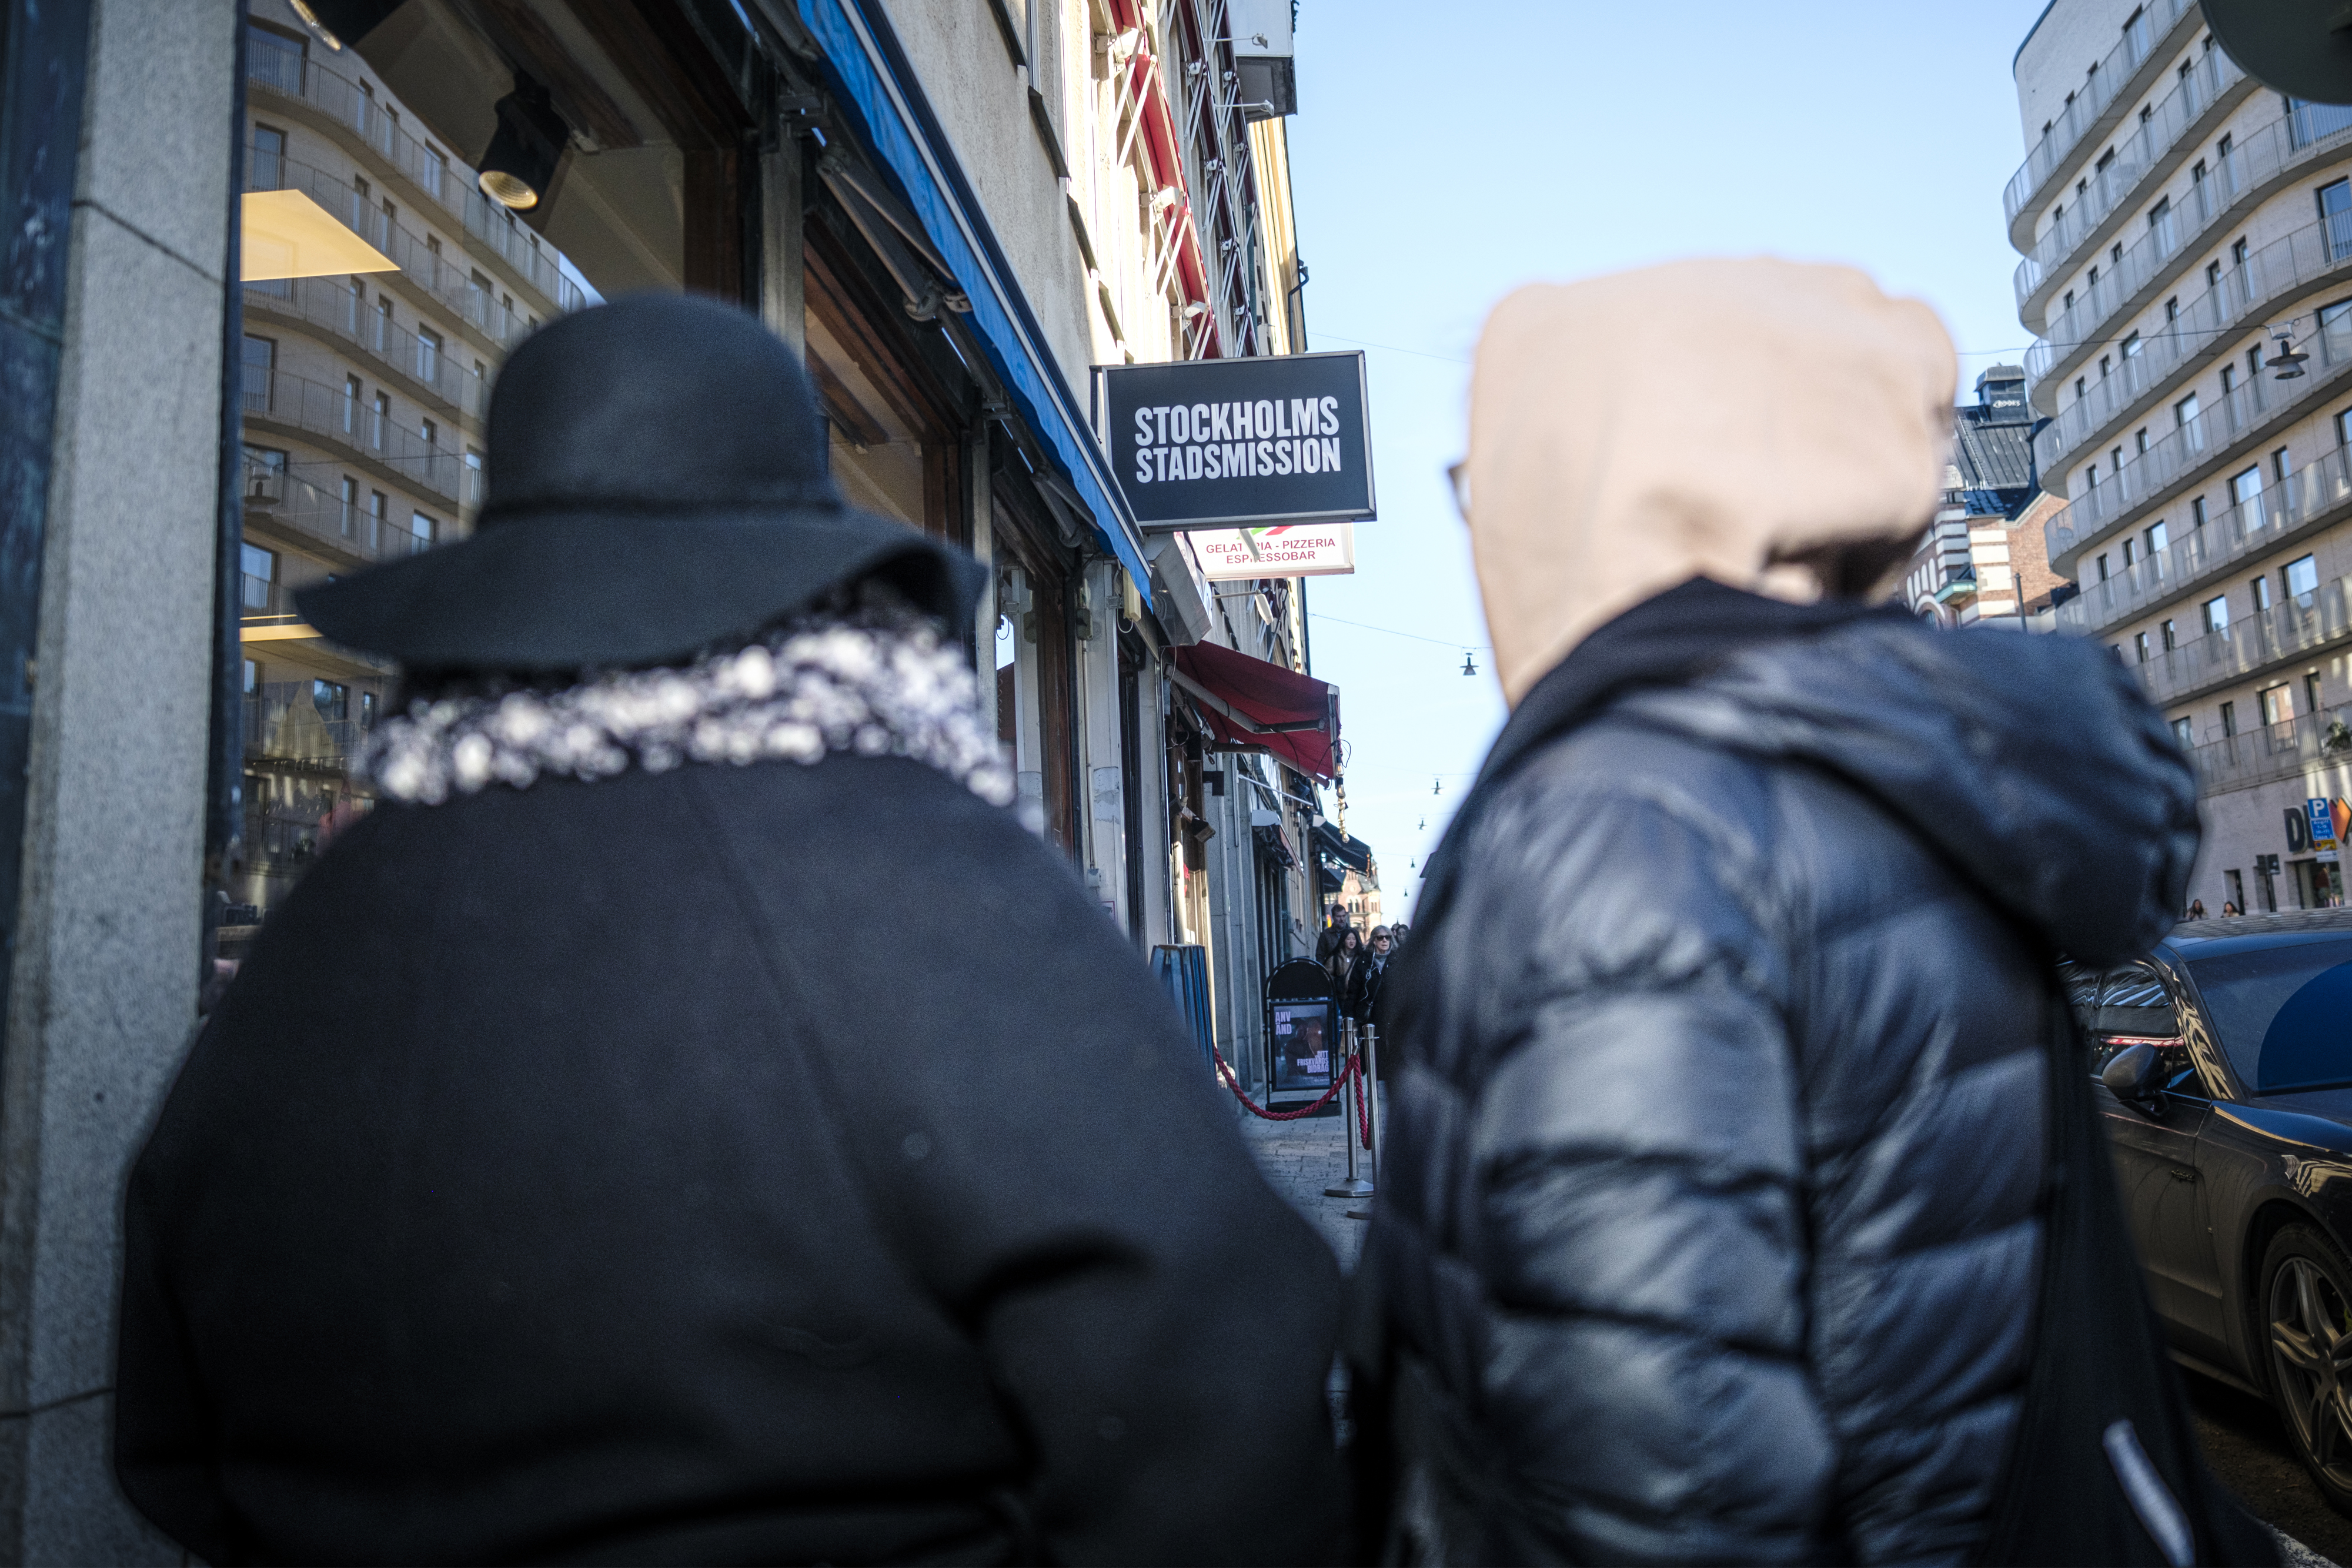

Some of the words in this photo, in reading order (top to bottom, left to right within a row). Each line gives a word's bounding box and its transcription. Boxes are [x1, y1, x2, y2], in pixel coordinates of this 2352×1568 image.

[1135, 396, 1339, 446] STOCKHOLMS
[1136, 437, 1341, 483] STADSMISSION
[1206, 541, 1272, 553] GELATIA
[1282, 538, 1336, 550] PIZZERIA
[1227, 551, 1316, 564] ESPESSOBAR
[2312, 800, 2325, 817] P
[1275, 1011, 1291, 1022] ANV
[1275, 1022, 1292, 1035] ÄND
[1317, 1050, 1329, 1058] DITT
[1307, 1064, 1329, 1074] BIDRAG
